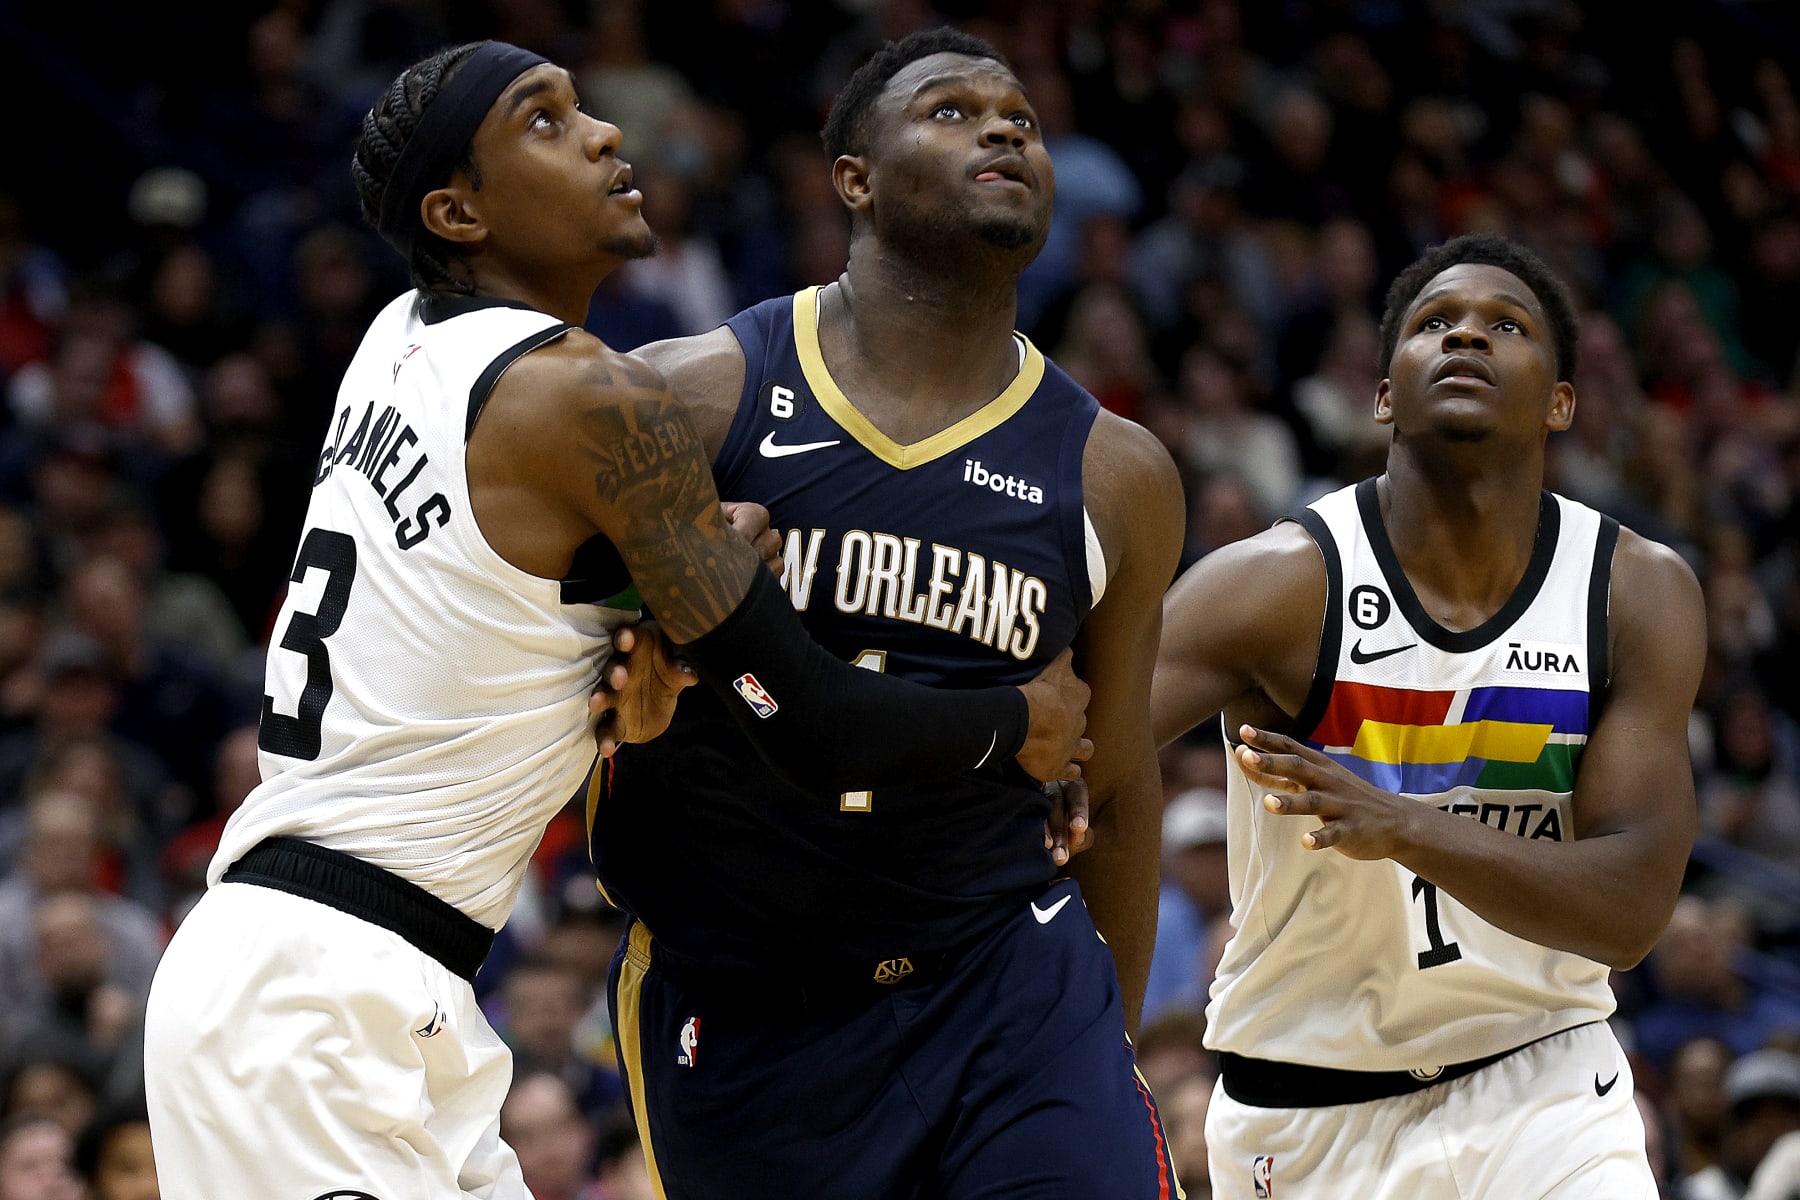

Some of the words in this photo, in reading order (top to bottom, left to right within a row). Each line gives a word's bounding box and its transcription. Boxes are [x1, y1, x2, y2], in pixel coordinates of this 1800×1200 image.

[771, 385, 795, 419] 6
[963, 459, 1044, 504] ibotta
[834, 529, 1047, 661] ORLEANS
[1356, 590, 1379, 625] 6
[258, 527, 357, 761] 3
[1411, 874, 1463, 970] 1
